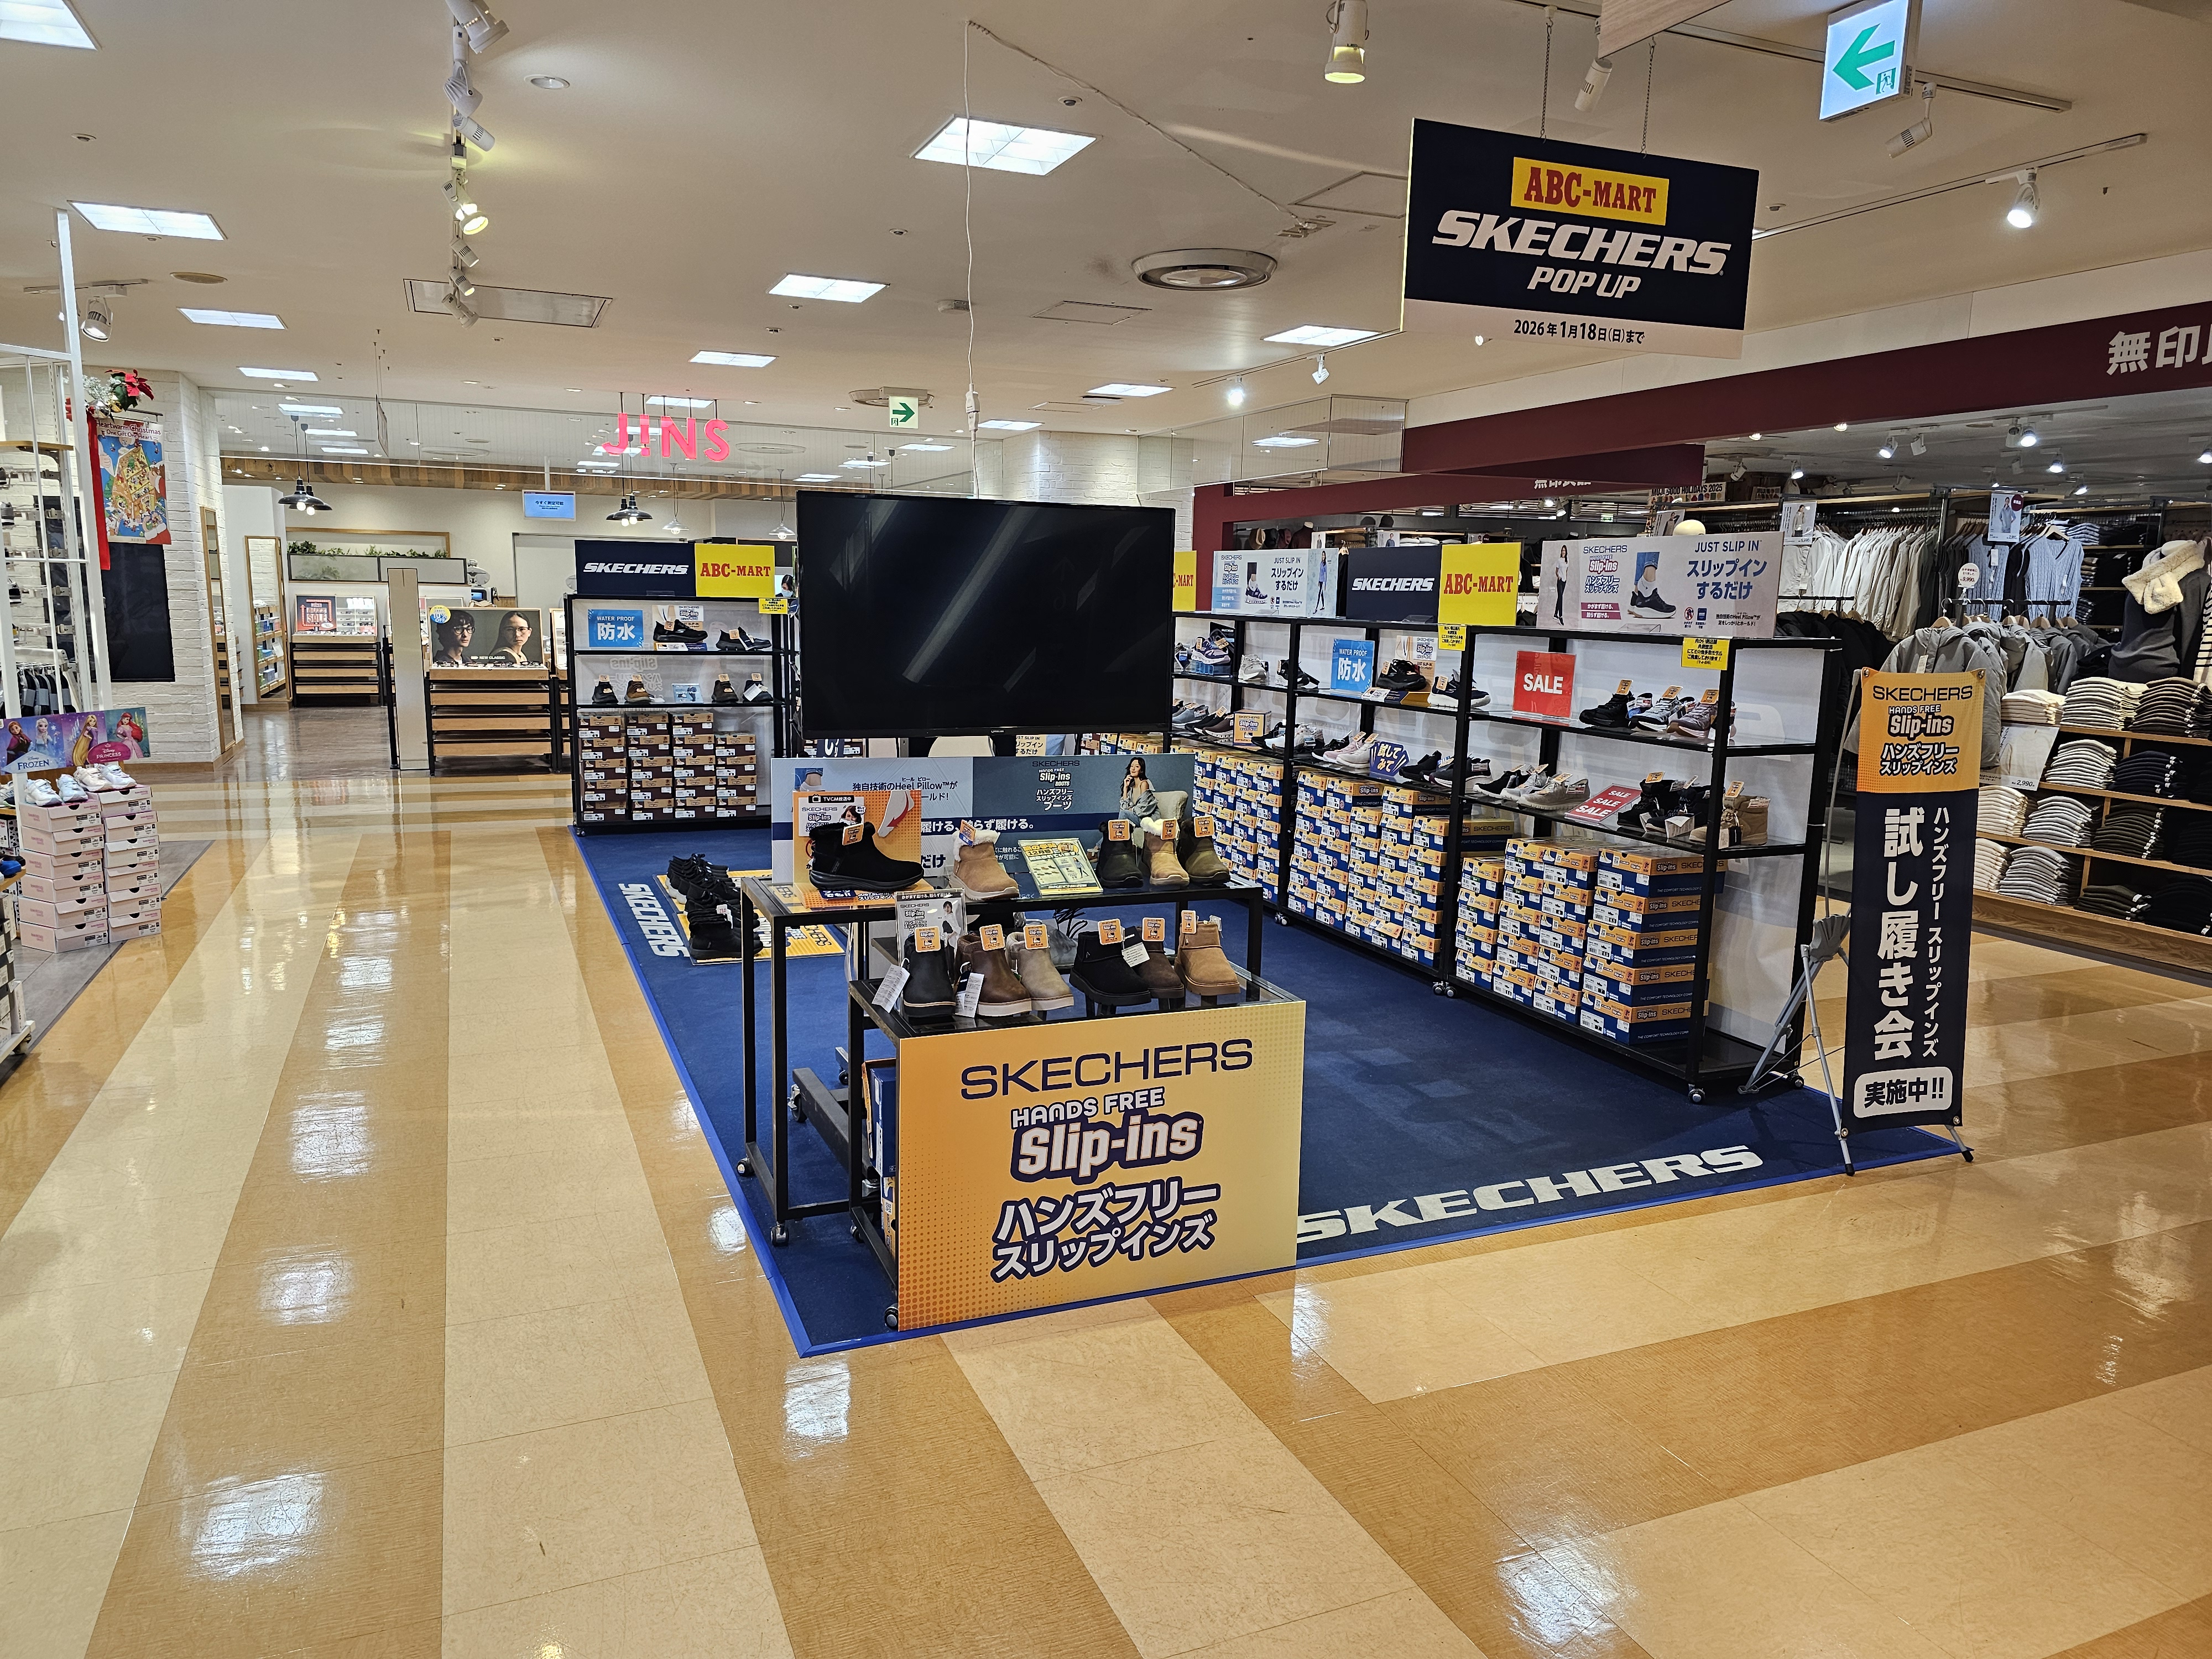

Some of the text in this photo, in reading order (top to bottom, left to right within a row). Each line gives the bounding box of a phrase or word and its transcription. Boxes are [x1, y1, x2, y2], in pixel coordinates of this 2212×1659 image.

[1524, 166, 1656, 213] ABC-MART
[1432, 210, 1731, 275] SKECHERS
[1527, 267, 1641, 299] POP UP
[2106, 324, 2212, 375] 無印
[130, 424, 161, 435] Christmas
[1651, 488, 1666, 497] MUJI
[1681, 484, 1707, 494] HOLIDAYS
[1709, 483, 1723, 492] 2025
[1583, 545, 1627, 554] SKECHERS
[1694, 541, 1719, 552] JUST
[1723, 540, 1745, 551] SLIP
[583, 562, 688, 575] SKECHERS
[700, 563, 771, 577] ABC-MART
[1271, 567, 1304, 578] スリップイン
[1589, 560, 1618, 573] Slip-ins
[1687, 559, 1768, 578] スリップイン
[1276, 581, 1298, 591] するだけ
[1352, 577, 1434, 591] SKECHERS
[1443, 573, 1514, 595] ABC-MART
[1585, 576, 1620, 585] ハンズフリー
[1697, 581, 1753, 600] するだけ
[597, 623, 635, 640] 防水
[1417, 645, 1433, 654] Slip-ins
[1338, 658, 1366, 682] 防水
[1523, 673, 1563, 695] SALE
[1873, 685, 1973, 701] SKECHERS
[1919, 705, 1941, 713] FREE
[1890, 714, 1953, 739] Slip-ins
[1378, 744, 1402, 759] 試して
[1881, 743, 1959, 760] ハンズフリー
[18, 759, 49, 770] FROZEN
[1378, 759, 1395, 773] みて
[1880, 759, 1957, 775] スリップインズ
[1040, 773, 1071, 782] Slip-ins
[853, 782, 914, 791] 独自技術のHeel
[1044, 800, 1072, 811] ブーツ
[1593, 797, 1621, 807] SALE
[1575, 805, 1613, 817] SALE
[1657, 864, 1676, 872] Slip-ins
[619, 883, 690, 957] SKECHERS
[1874, 806, 1926, 1060] 試し履き会
[1922, 806, 1949, 1057] ハンズフリー スリップインズ
[1640, 973, 1659, 982] Slip-ins
[1638, 1011, 1657, 1019] Slip-ins
[961, 1039, 1253, 1100] SKECHERS
[1864, 1076, 1945, 1108] 実施中!!
[1012, 1087, 1165, 1129] HANDS FREE
[1018, 1114, 1200, 1178] Slip-ins
[1297, 1145, 1764, 1244] SKECHERS
[994, 1180, 1220, 1242] ハンズフリー
[993, 1212, 1214, 1280] スリップインズ
